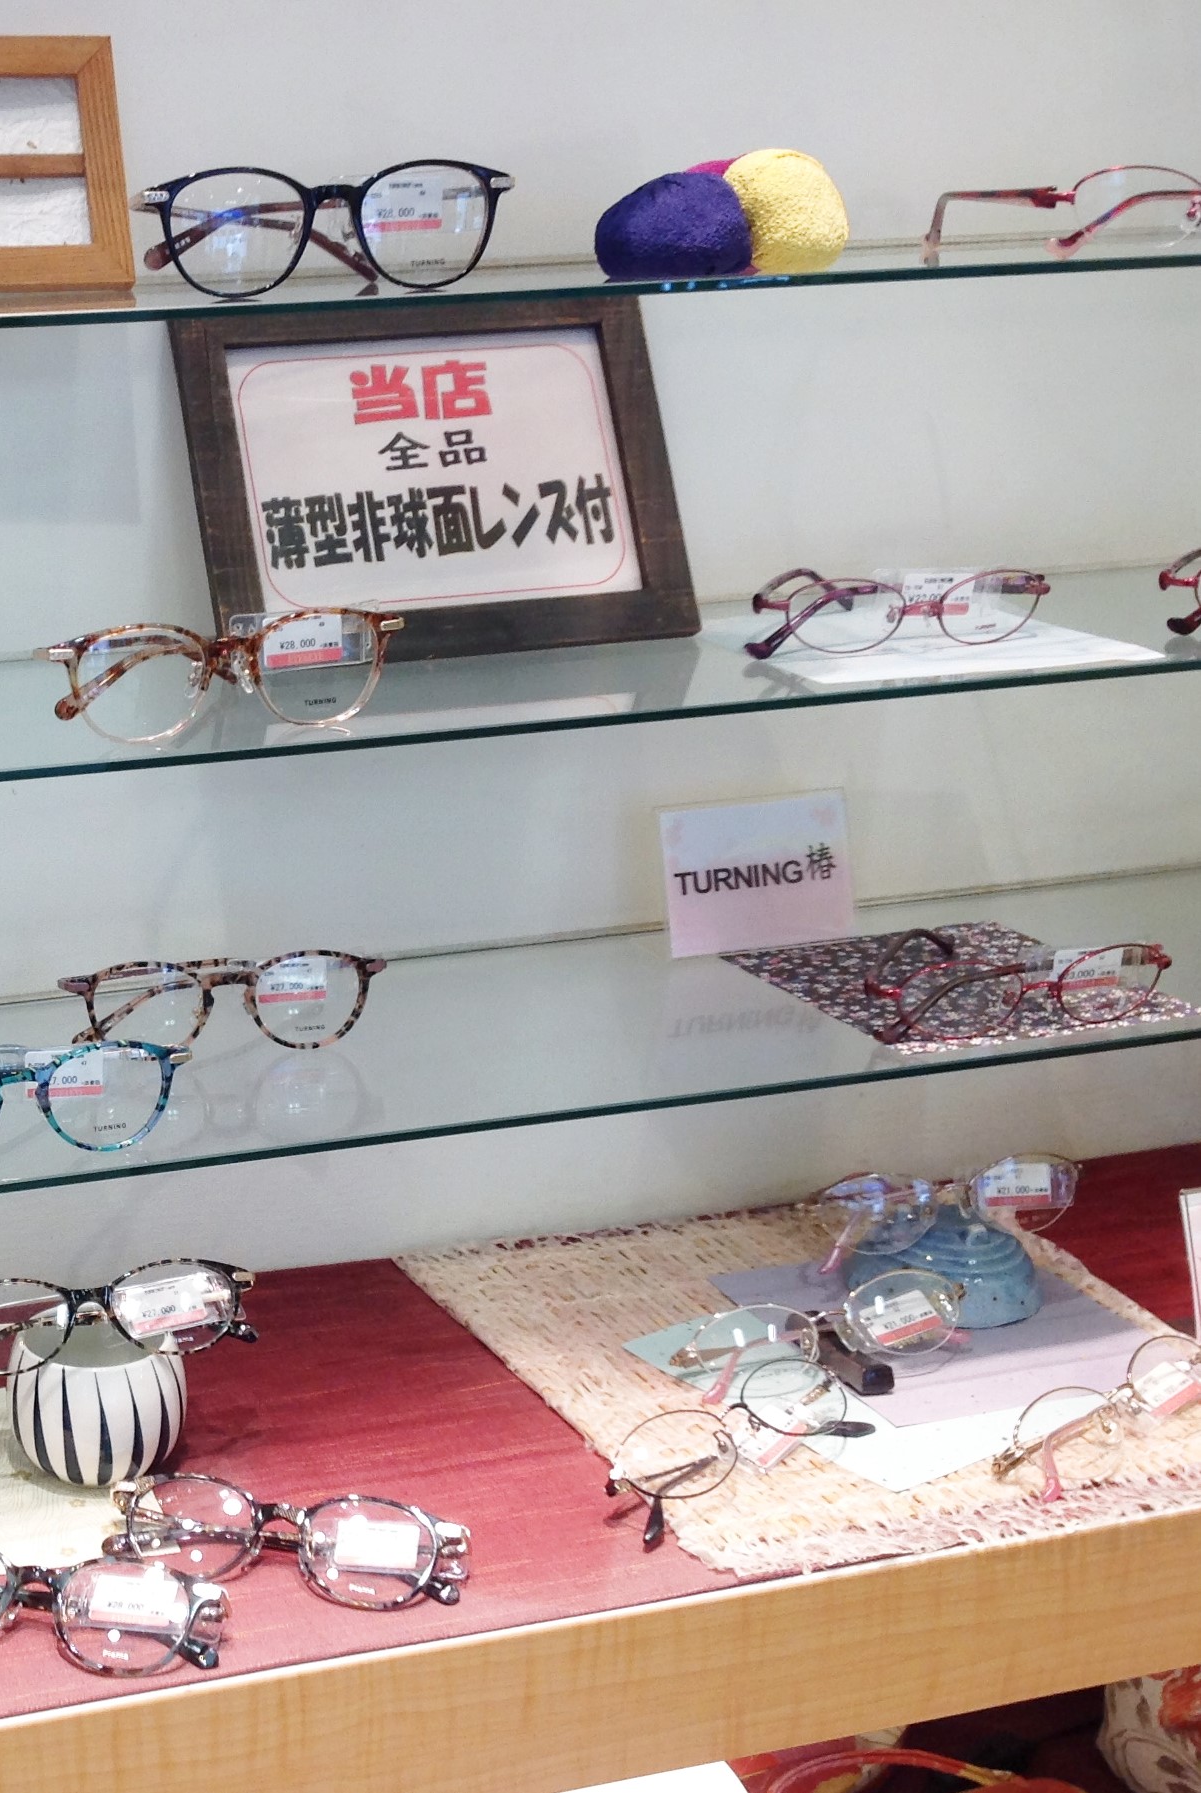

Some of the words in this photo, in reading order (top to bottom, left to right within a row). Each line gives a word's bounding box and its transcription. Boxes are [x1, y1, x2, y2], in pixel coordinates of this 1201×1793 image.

[350, 360, 492, 425] 当店
[378, 429, 488, 472] 全品
[262, 473, 614, 570] 薄型非球面レンズ付
[279, 638, 316, 650] ¥28,000
[93, 1122, 127, 1132] TURNING
